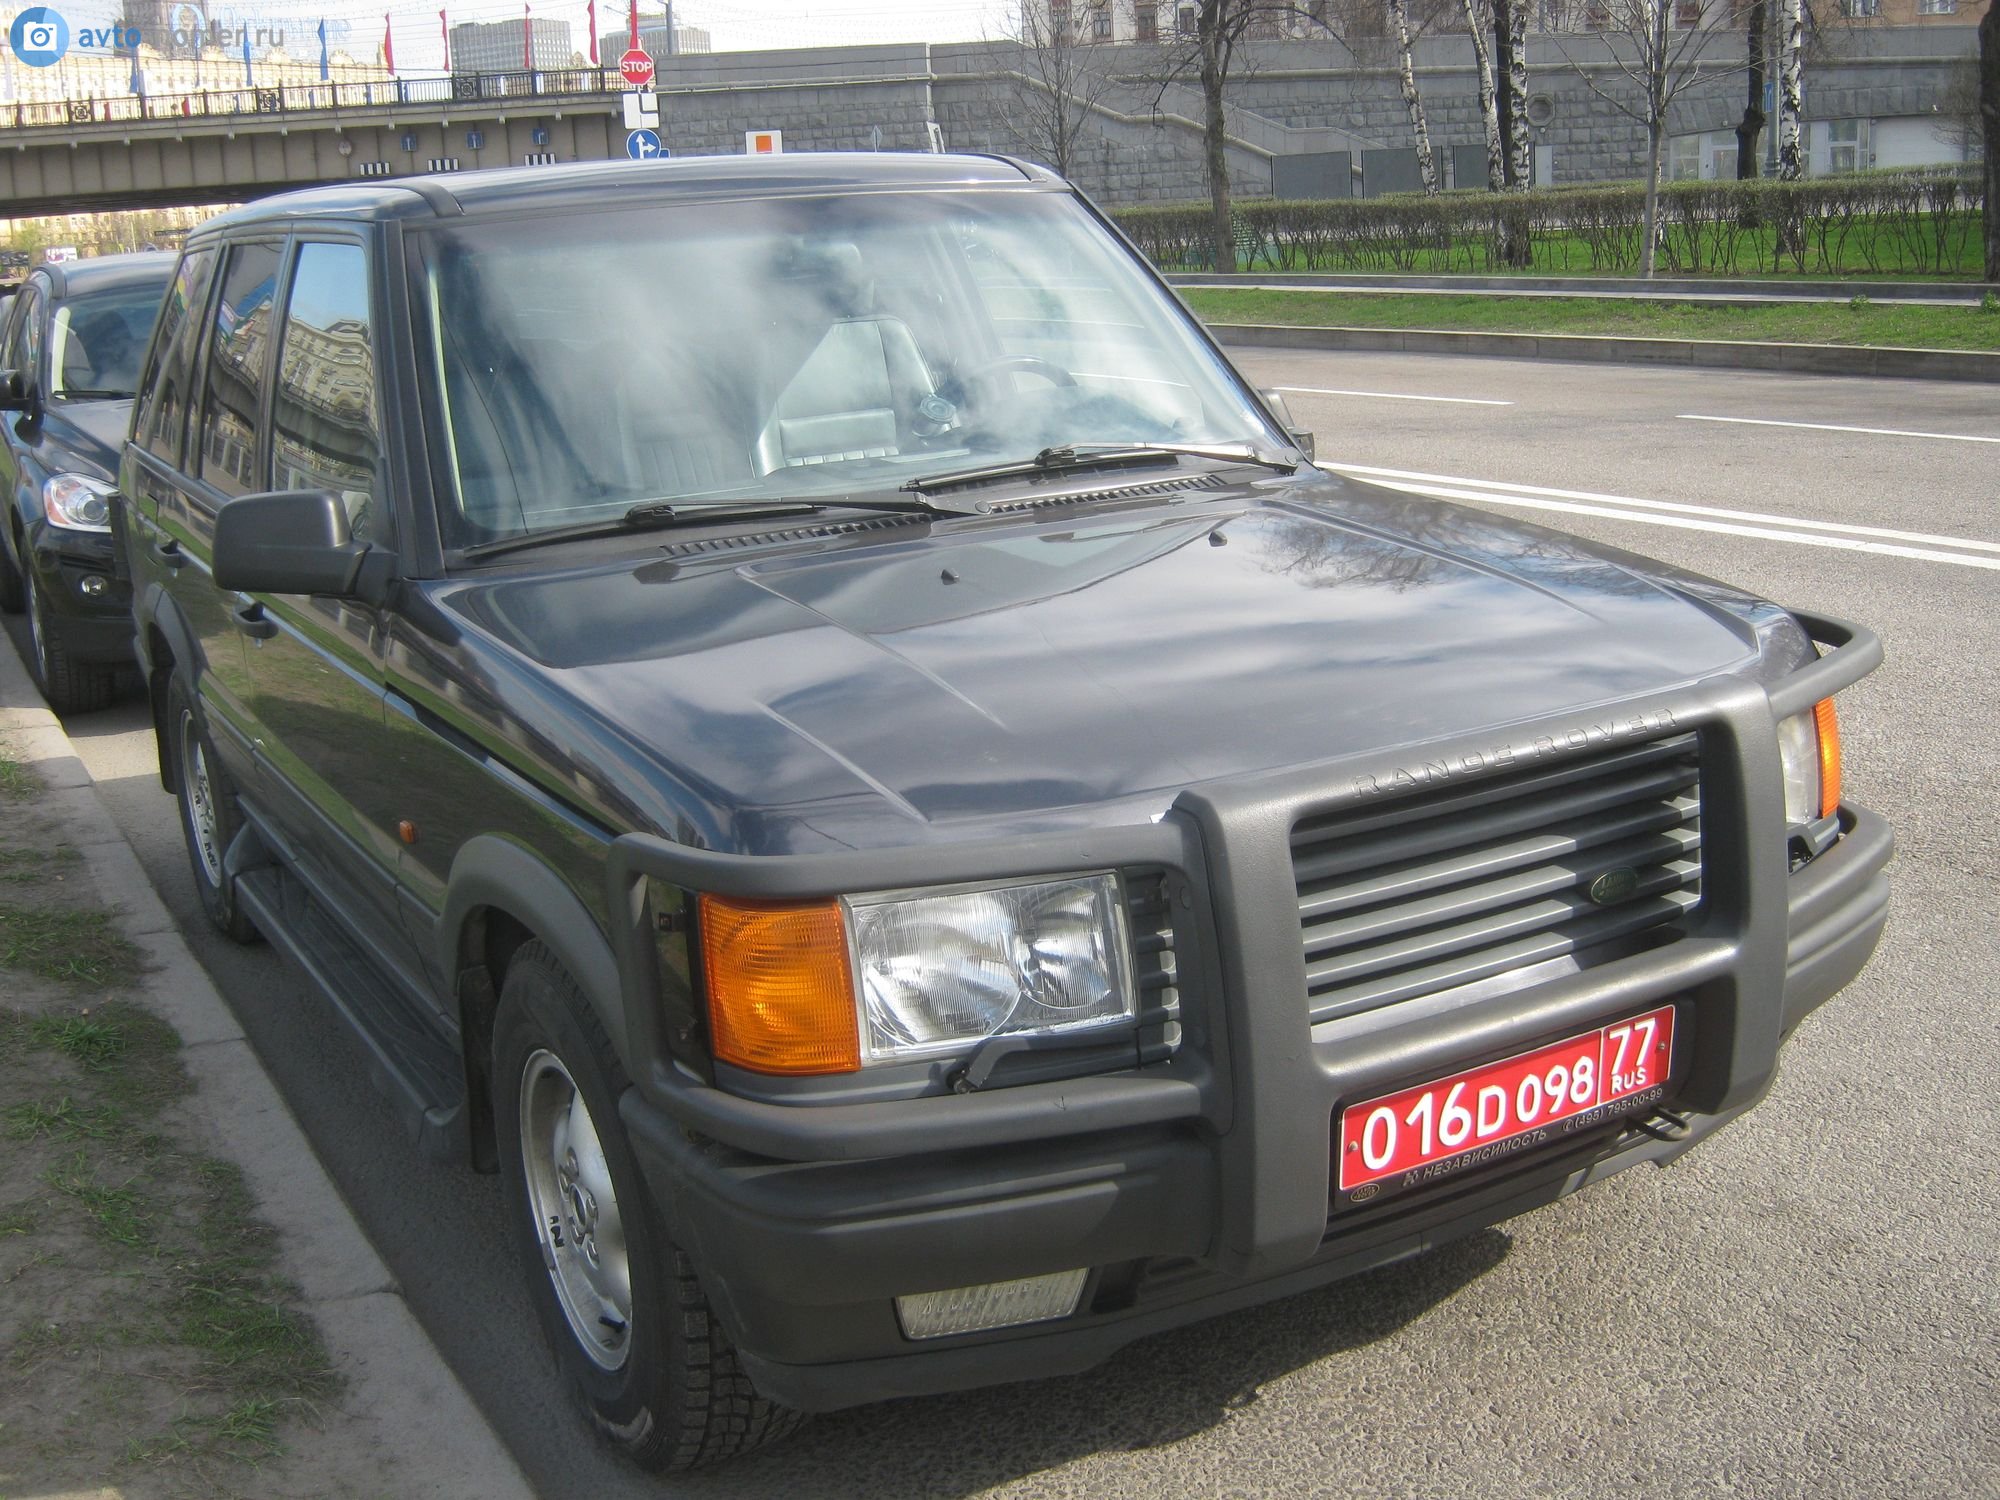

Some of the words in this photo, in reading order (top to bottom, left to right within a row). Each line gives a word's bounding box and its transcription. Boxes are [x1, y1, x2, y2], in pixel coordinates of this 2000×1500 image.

[621, 61, 652, 73] STOP
[1352, 743, 1516, 798] RANGE
[1533, 707, 1681, 758] ROVER
[1361, 1055, 1595, 1170] 016D098
[1609, 1017, 1656, 1075] 77
[1611, 1068, 1647, 1095] RUS
[1423, 1129, 1547, 1181] НЕЗАВИСИМОСТЬ
[1607, 1087, 1663, 1116] 795-00-99
